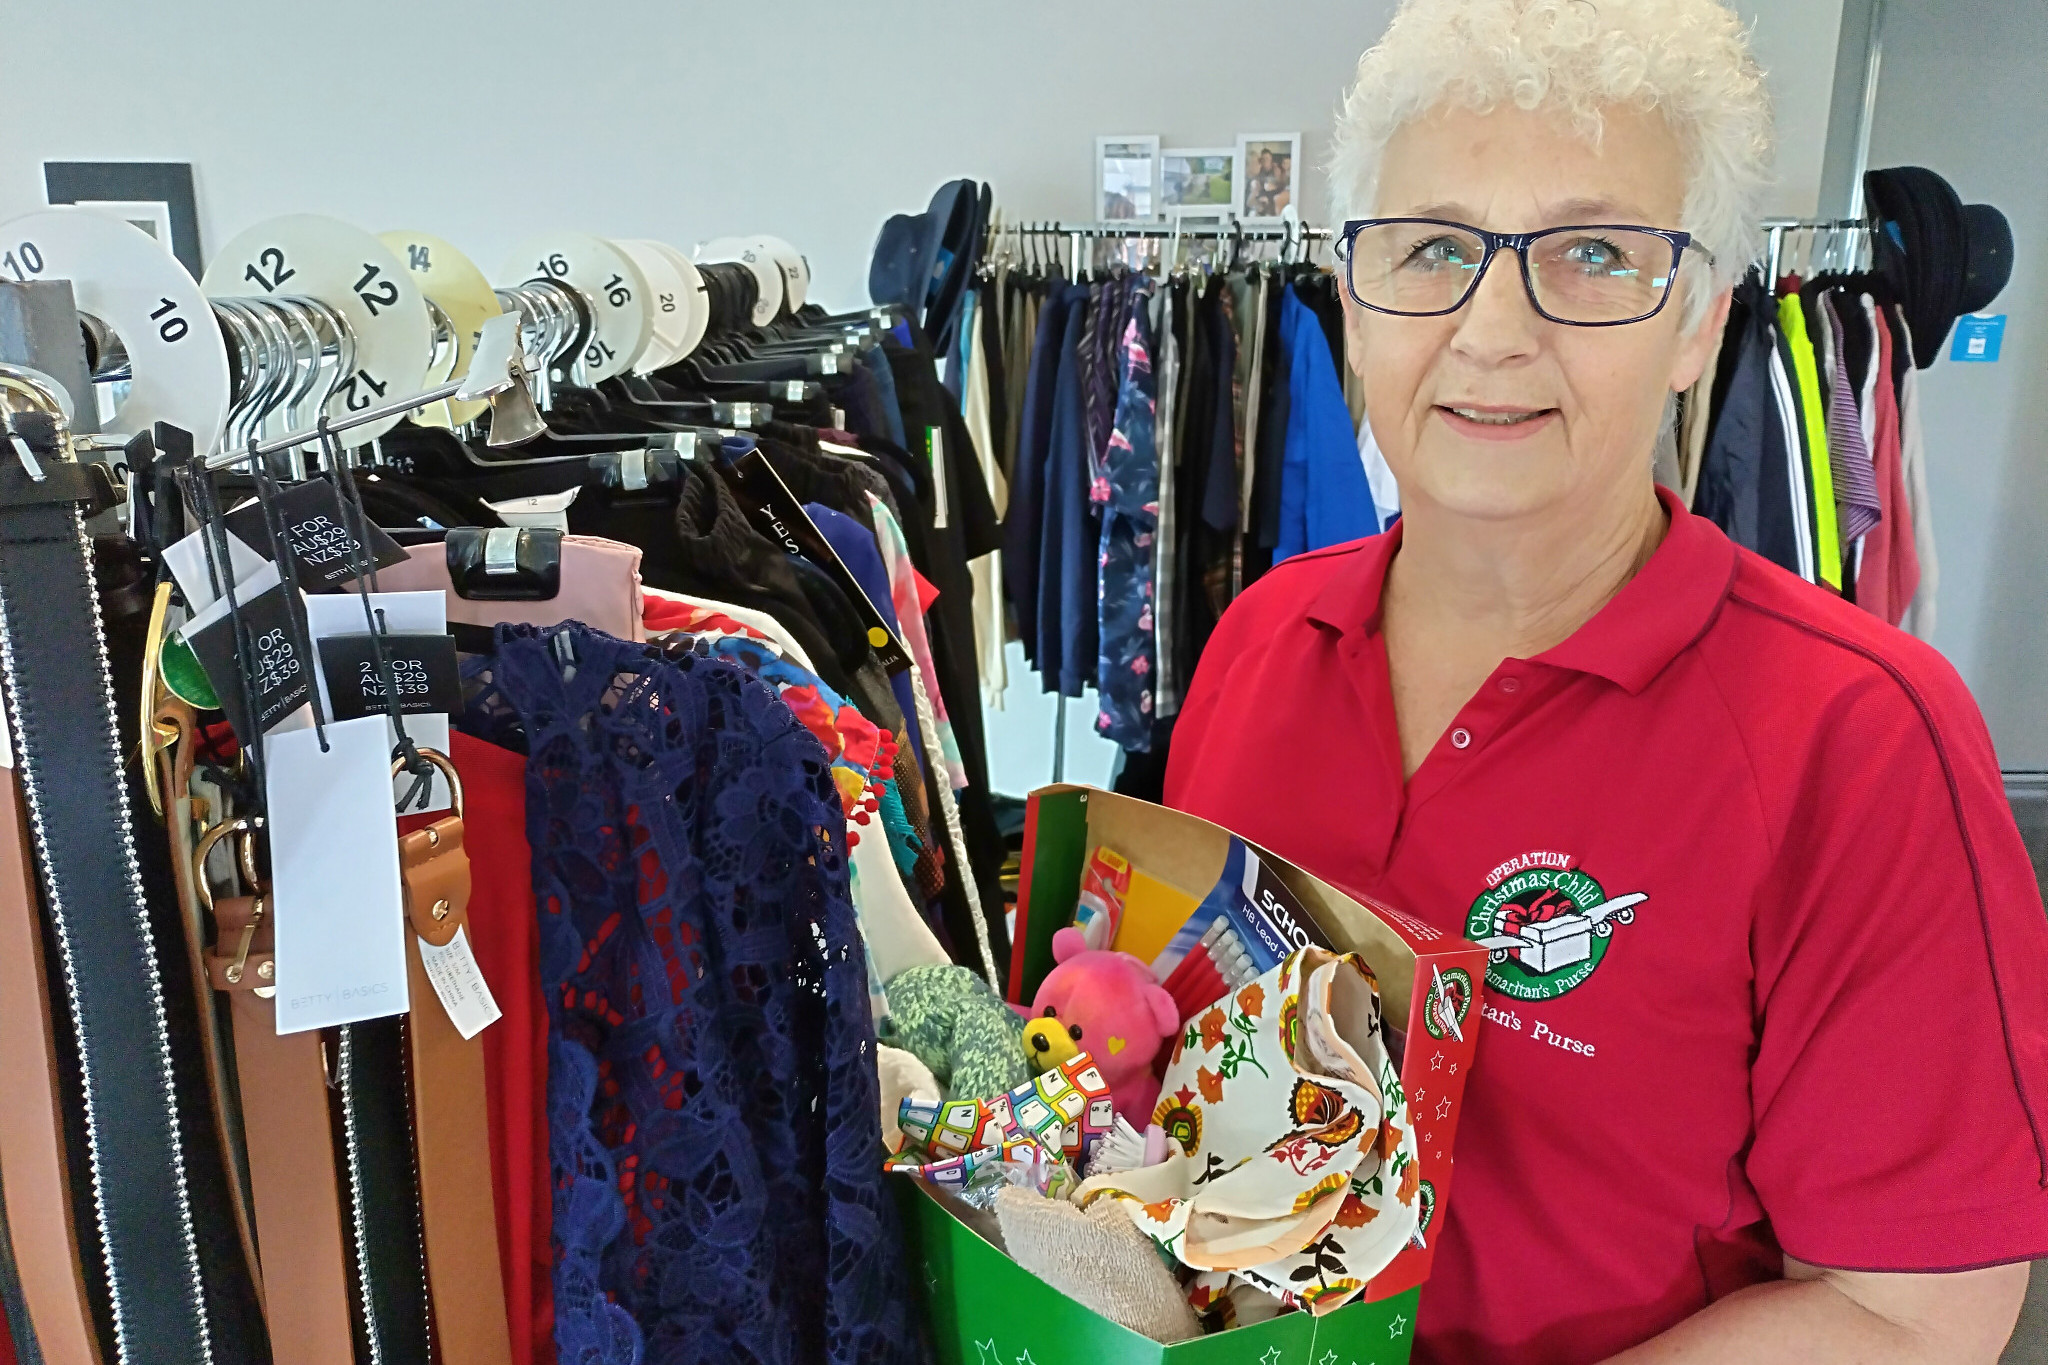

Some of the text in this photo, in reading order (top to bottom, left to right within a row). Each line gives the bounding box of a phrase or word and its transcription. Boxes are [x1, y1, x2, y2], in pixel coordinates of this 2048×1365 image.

[2, 242, 44, 281] 10
[245, 247, 296, 293] 12
[408, 244, 432, 273] 14
[537, 253, 569, 279] 16
[353, 263, 399, 316] 12
[604, 273, 631, 308] 16
[660, 293, 676, 313] 20
[150, 297, 189, 344] 10
[585, 340, 616, 368] 16
[338, 369, 388, 412] 12
[291, 516, 333, 537] FOR
[292, 527, 347, 556] AU$29
[760, 503, 799, 555] YES
[324, 566, 349, 580] BETTY
[258, 628, 286, 651] OR
[259, 659, 299, 696] Z$39
[360, 661, 372, 673] 2
[1485, 851, 1571, 887] OPERATION
[1260, 889, 1314, 951] SCHO
[1469, 871, 1550, 938] Christmas
[1553, 871, 1600, 908] Child
[1242, 903, 1256, 923] HB
[1255, 921, 1279, 952] Lead
[291, 982, 389, 1010] BETTY BASICS
[452, 941, 494, 1021] BETTY BASICS
[1485, 961, 1595, 998] amaritan's Purse
[1457, 996, 1471, 1022] Purse
[1481, 1002, 1596, 1058] tan's Purse
[1048, 1071, 1059, 1084] N
[1086, 1069, 1098, 1081] F
